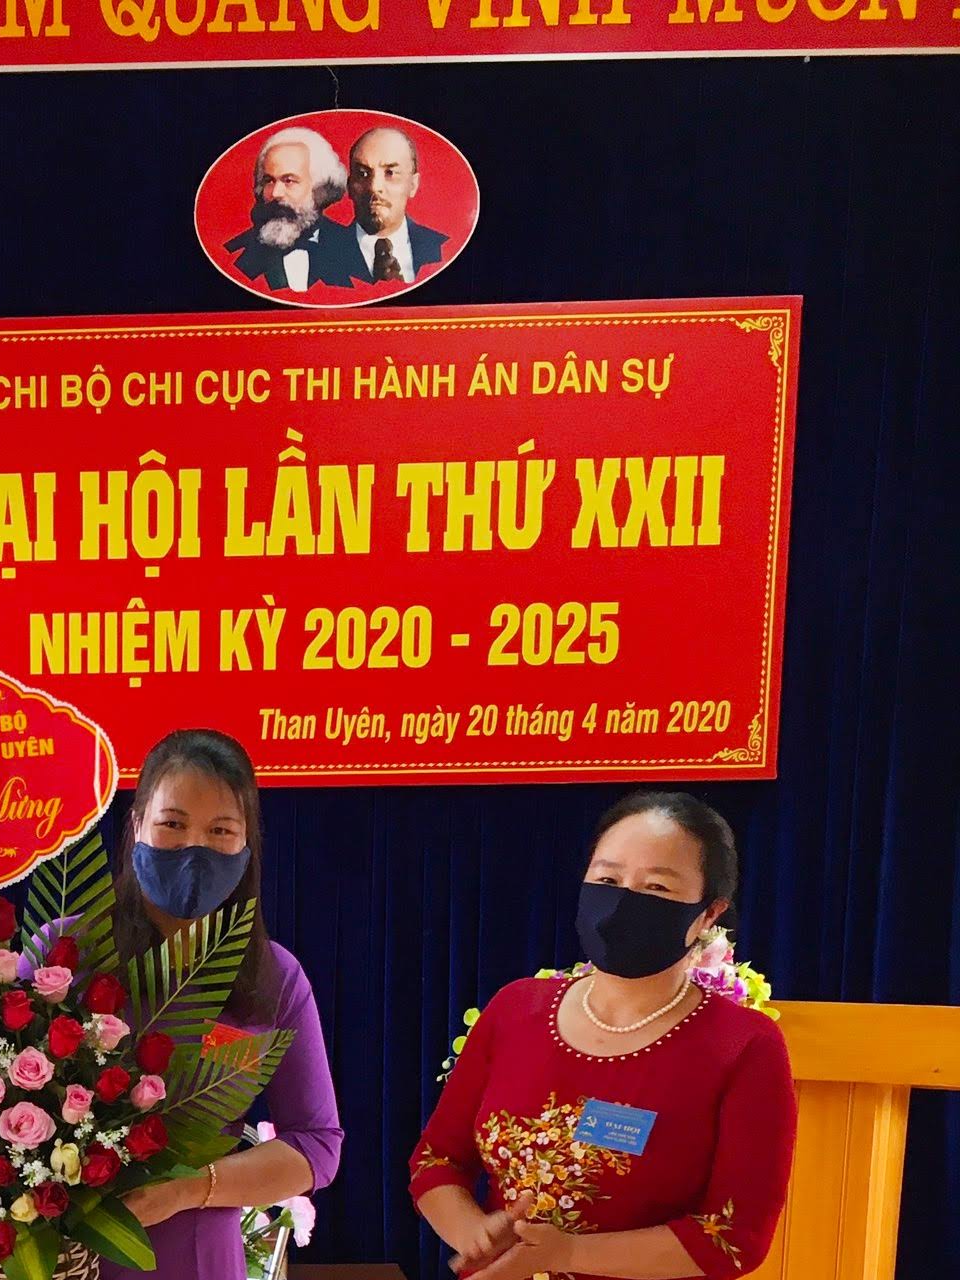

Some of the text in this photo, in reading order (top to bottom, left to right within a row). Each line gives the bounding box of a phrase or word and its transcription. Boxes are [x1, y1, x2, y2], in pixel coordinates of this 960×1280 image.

[61, 365, 111, 414] BỘ
[123, 372, 182, 406] CHI
[196, 369, 270, 410] CỤC
[283, 368, 340, 401] THI
[354, 356, 455, 399] HÀNH
[468, 353, 518, 396] ÁN
[532, 351, 608, 394] DÂN
[622, 353, 674, 399] SỰ
[80, 449, 201, 577] HỘI
[224, 428, 375, 557] LẦN
[396, 439, 556, 552] THỨ
[571, 455, 725, 548] XXII
[29, 599, 200, 688] NHIỆM
[220, 595, 286, 671] KỲ
[303, 606, 432, 669] 2020
[488, 602, 619, 665] 2025
[0, 710, 27, 734] BỘ
[1, 736, 54, 759] UYÊN
[260, 700, 730, 745] Than Uyên, ngày 20 tháng 4 năm 2020
